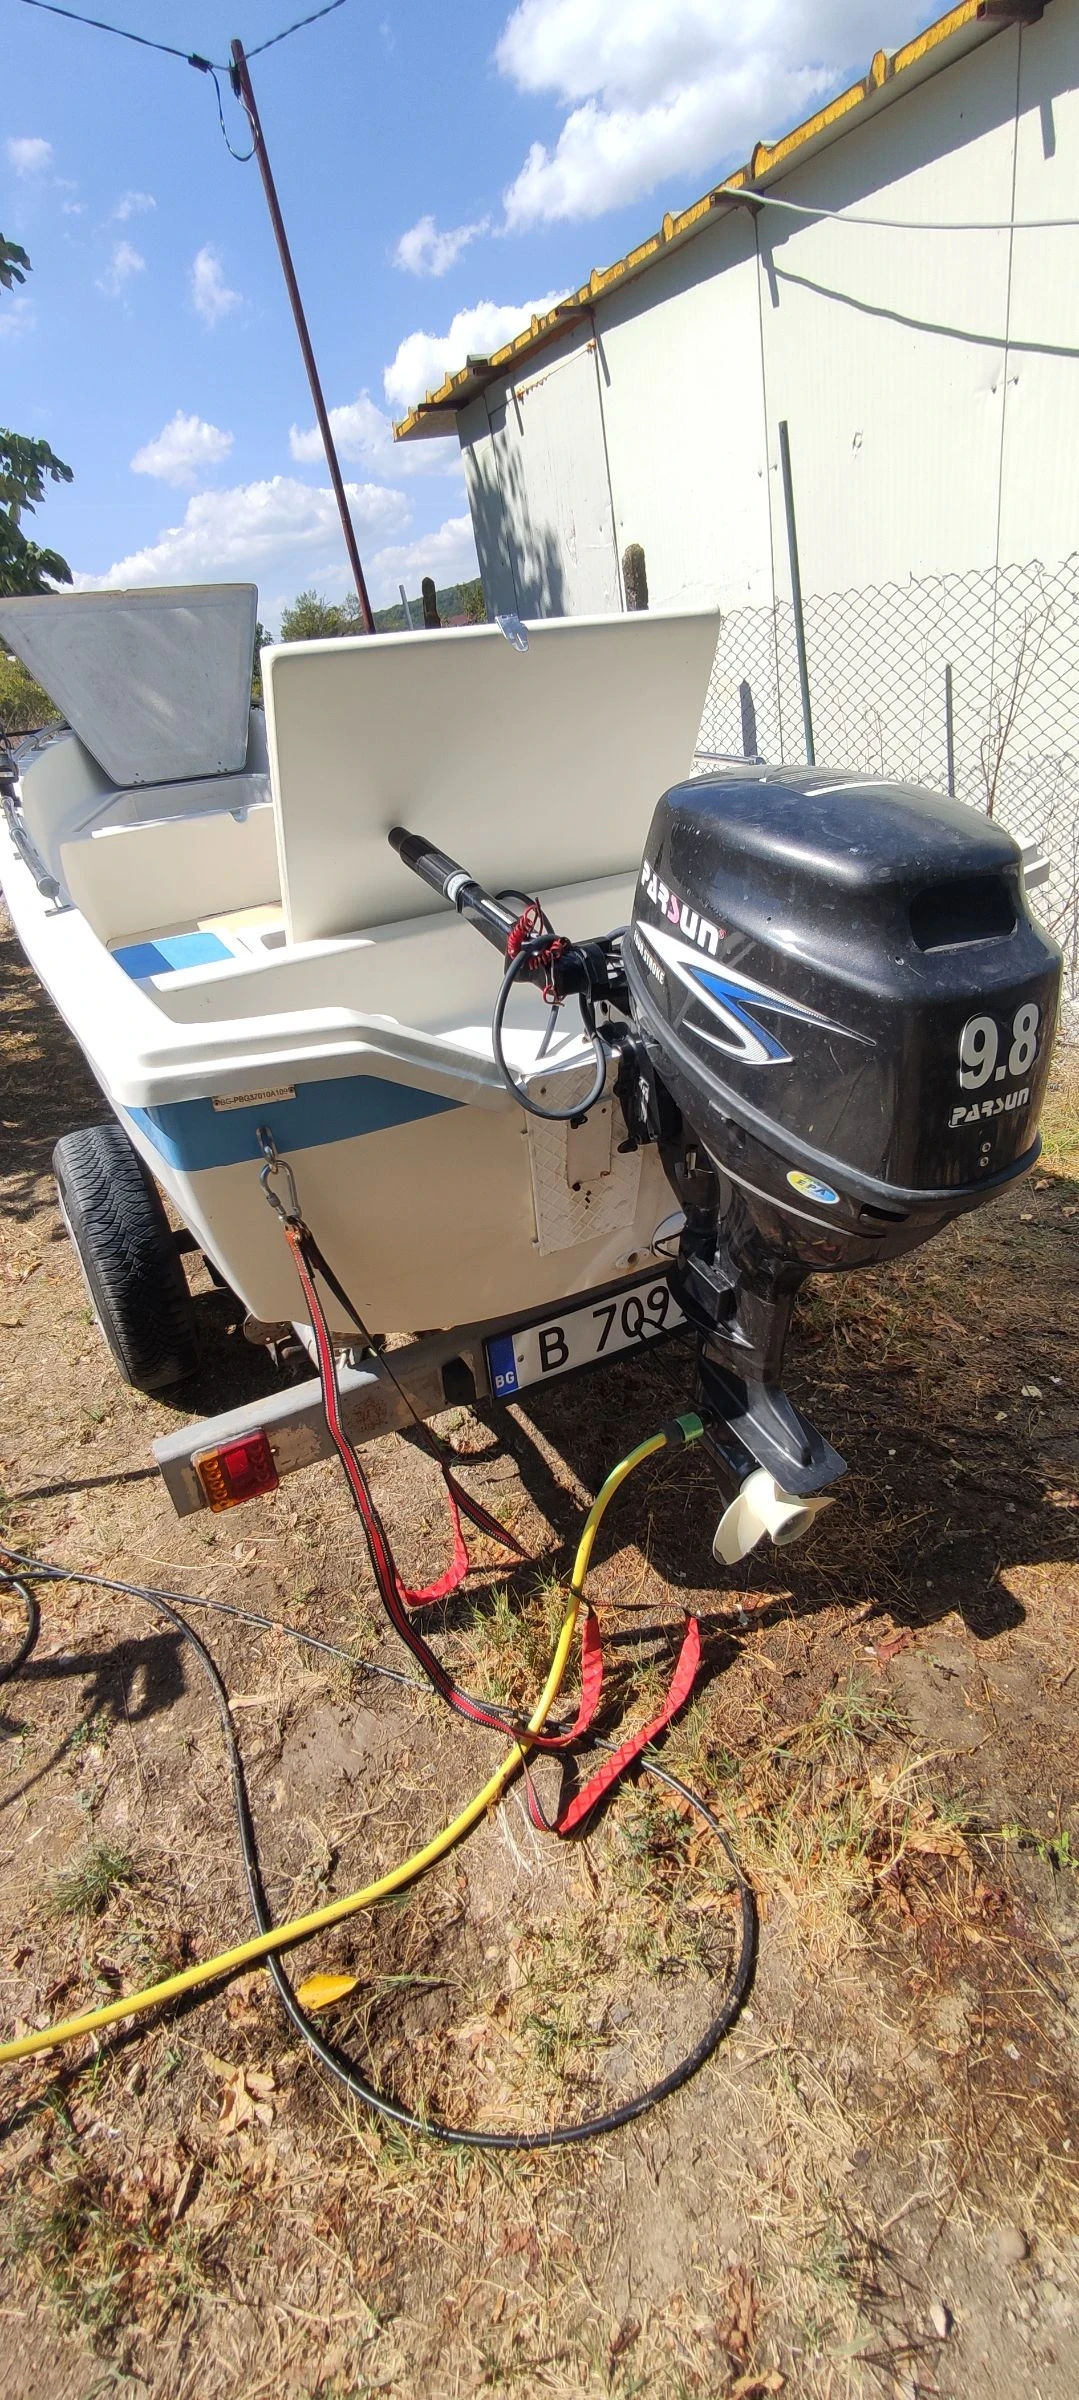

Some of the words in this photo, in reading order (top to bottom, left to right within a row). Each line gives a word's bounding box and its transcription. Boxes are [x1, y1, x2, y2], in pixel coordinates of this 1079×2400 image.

[641, 859, 719, 956] PARSUN
[961, 1003, 1039, 1090] 9.8
[951, 1087, 1030, 1126] PARSUN
[538, 1326, 570, 1373] B
[592, 1285, 687, 1353] 709
[494, 1370, 516, 1389] BG
